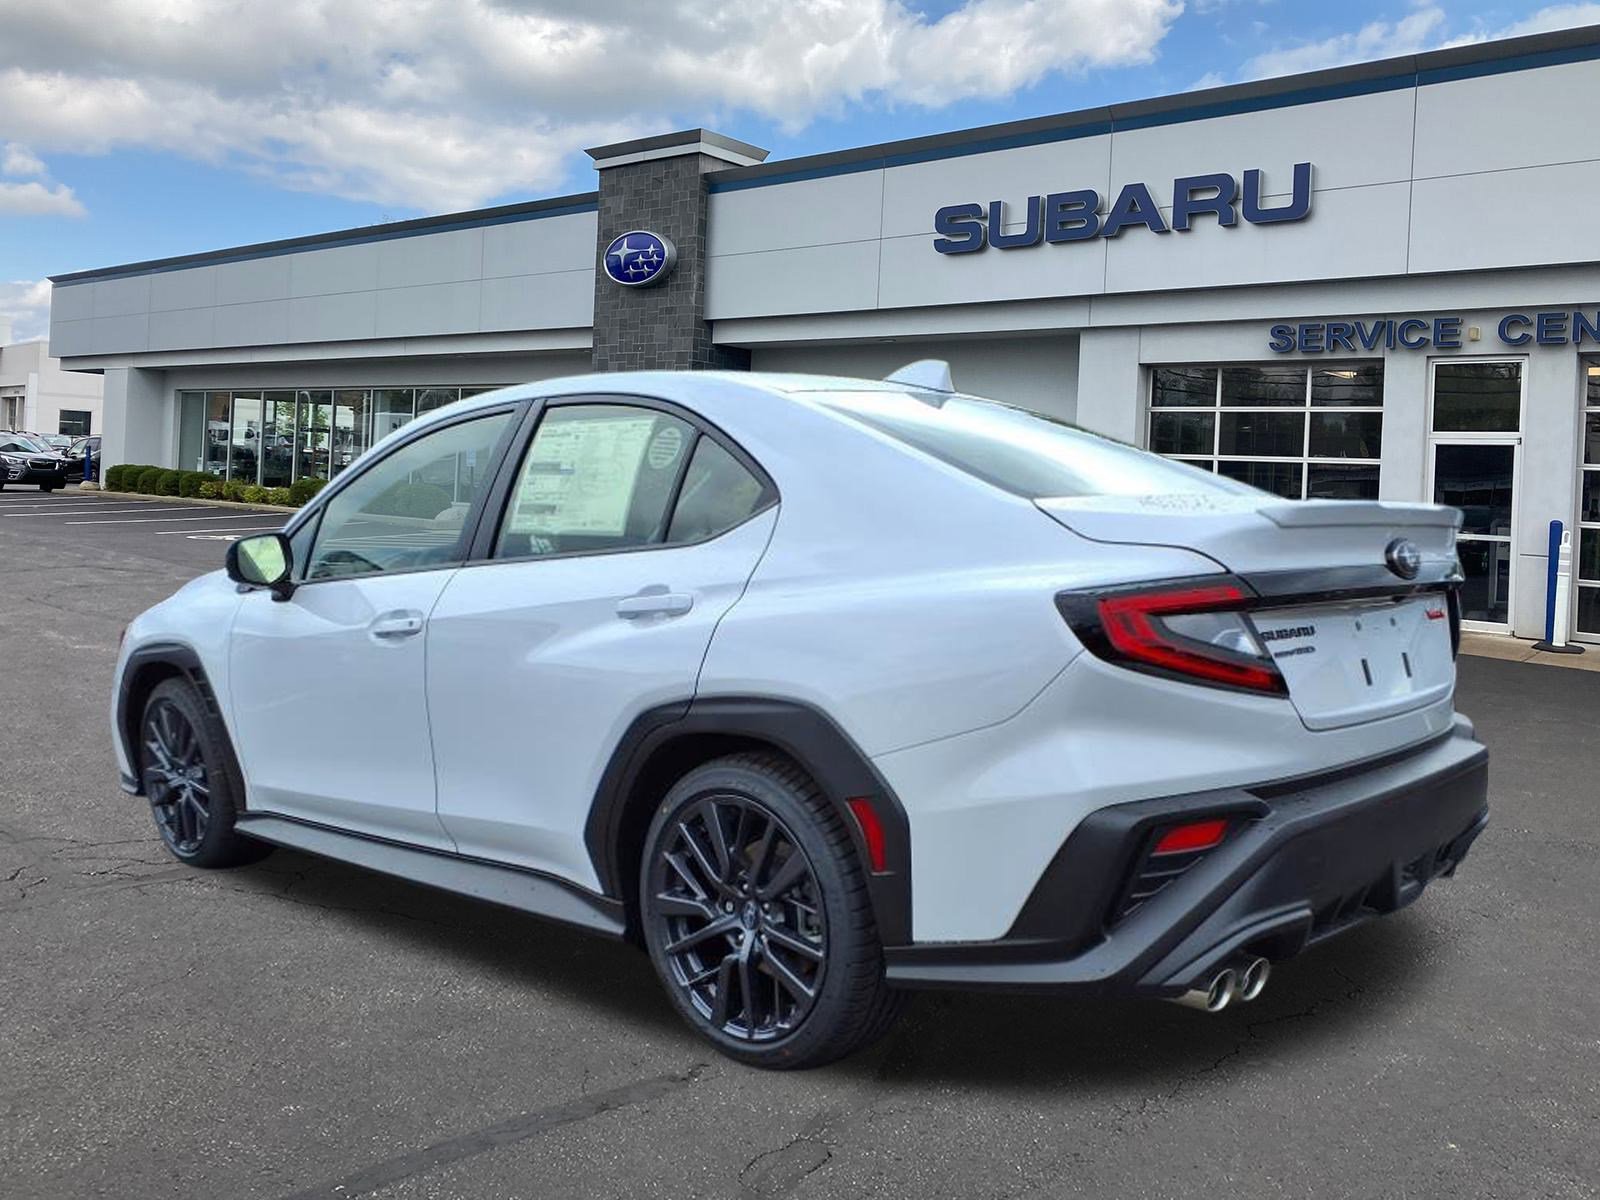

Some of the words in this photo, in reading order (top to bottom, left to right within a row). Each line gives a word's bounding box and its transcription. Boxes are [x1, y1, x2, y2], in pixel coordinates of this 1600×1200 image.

[934, 162, 1312, 255] SUBARU
[1268, 317, 1464, 354] SERVICE
[1260, 626, 1315, 641] SUBARU
